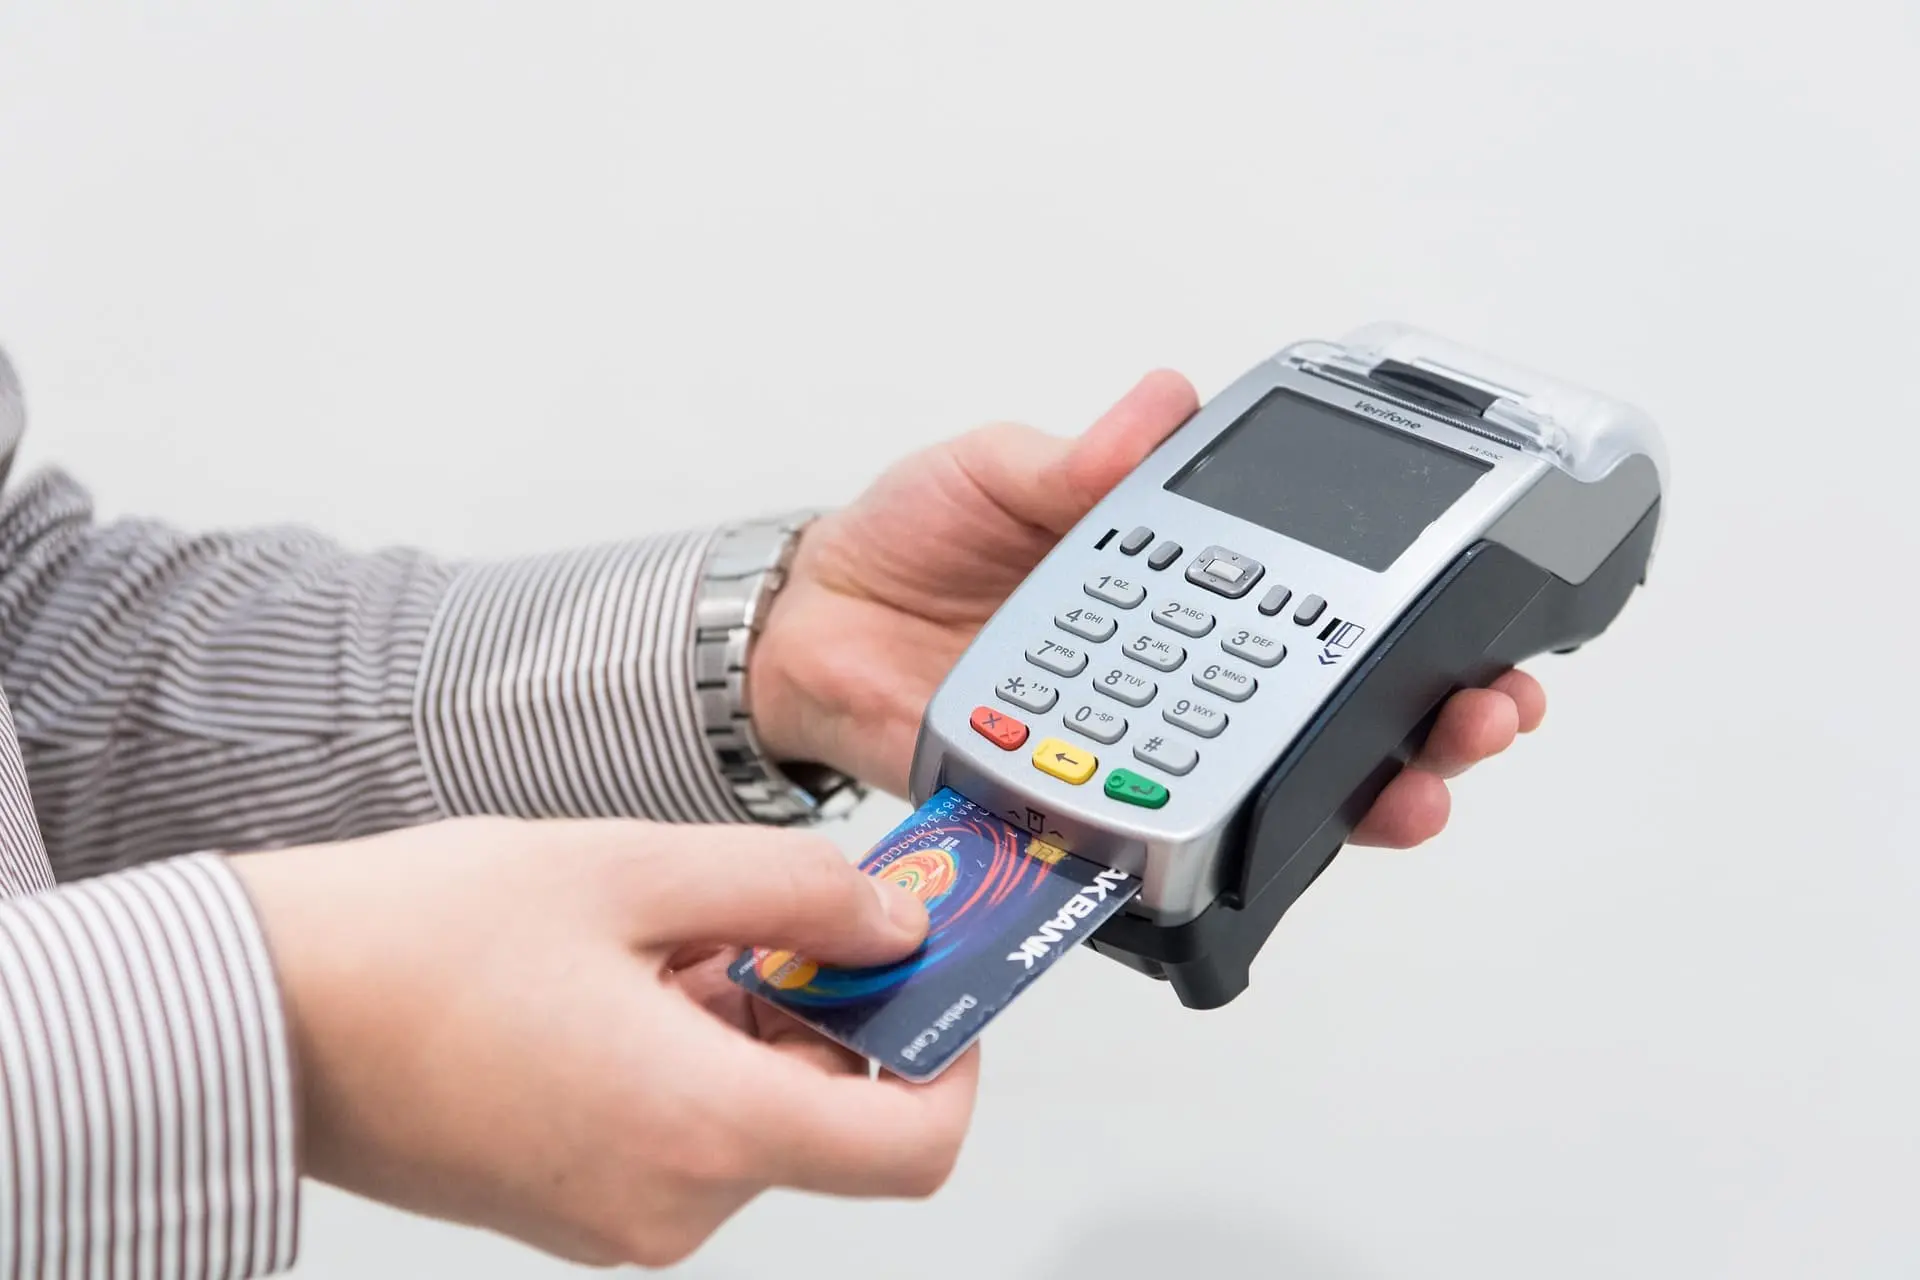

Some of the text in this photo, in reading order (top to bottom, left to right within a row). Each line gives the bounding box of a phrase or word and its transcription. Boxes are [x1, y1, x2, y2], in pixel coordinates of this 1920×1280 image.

[1354, 400, 1422, 430] Verifone
[1098, 575, 1112, 589] 1
[1065, 608, 1104, 625] 4 GHI
[1161, 602, 1205, 621] 2 ABC
[1036, 639, 1076, 659] 7 PRS
[1132, 635, 1171, 654] 5 JKL
[1231, 630, 1274, 649] 3 DEF
[1104, 669, 1146, 688] 8 TUV
[1202, 664, 1247, 684] 6 MNO
[1074, 705, 1092, 722] 0
[1172, 699, 1216, 718] 9 WXY
[1005, 864, 1130, 970] AKBANK
[901, 993, 978, 1062] Debit Card
